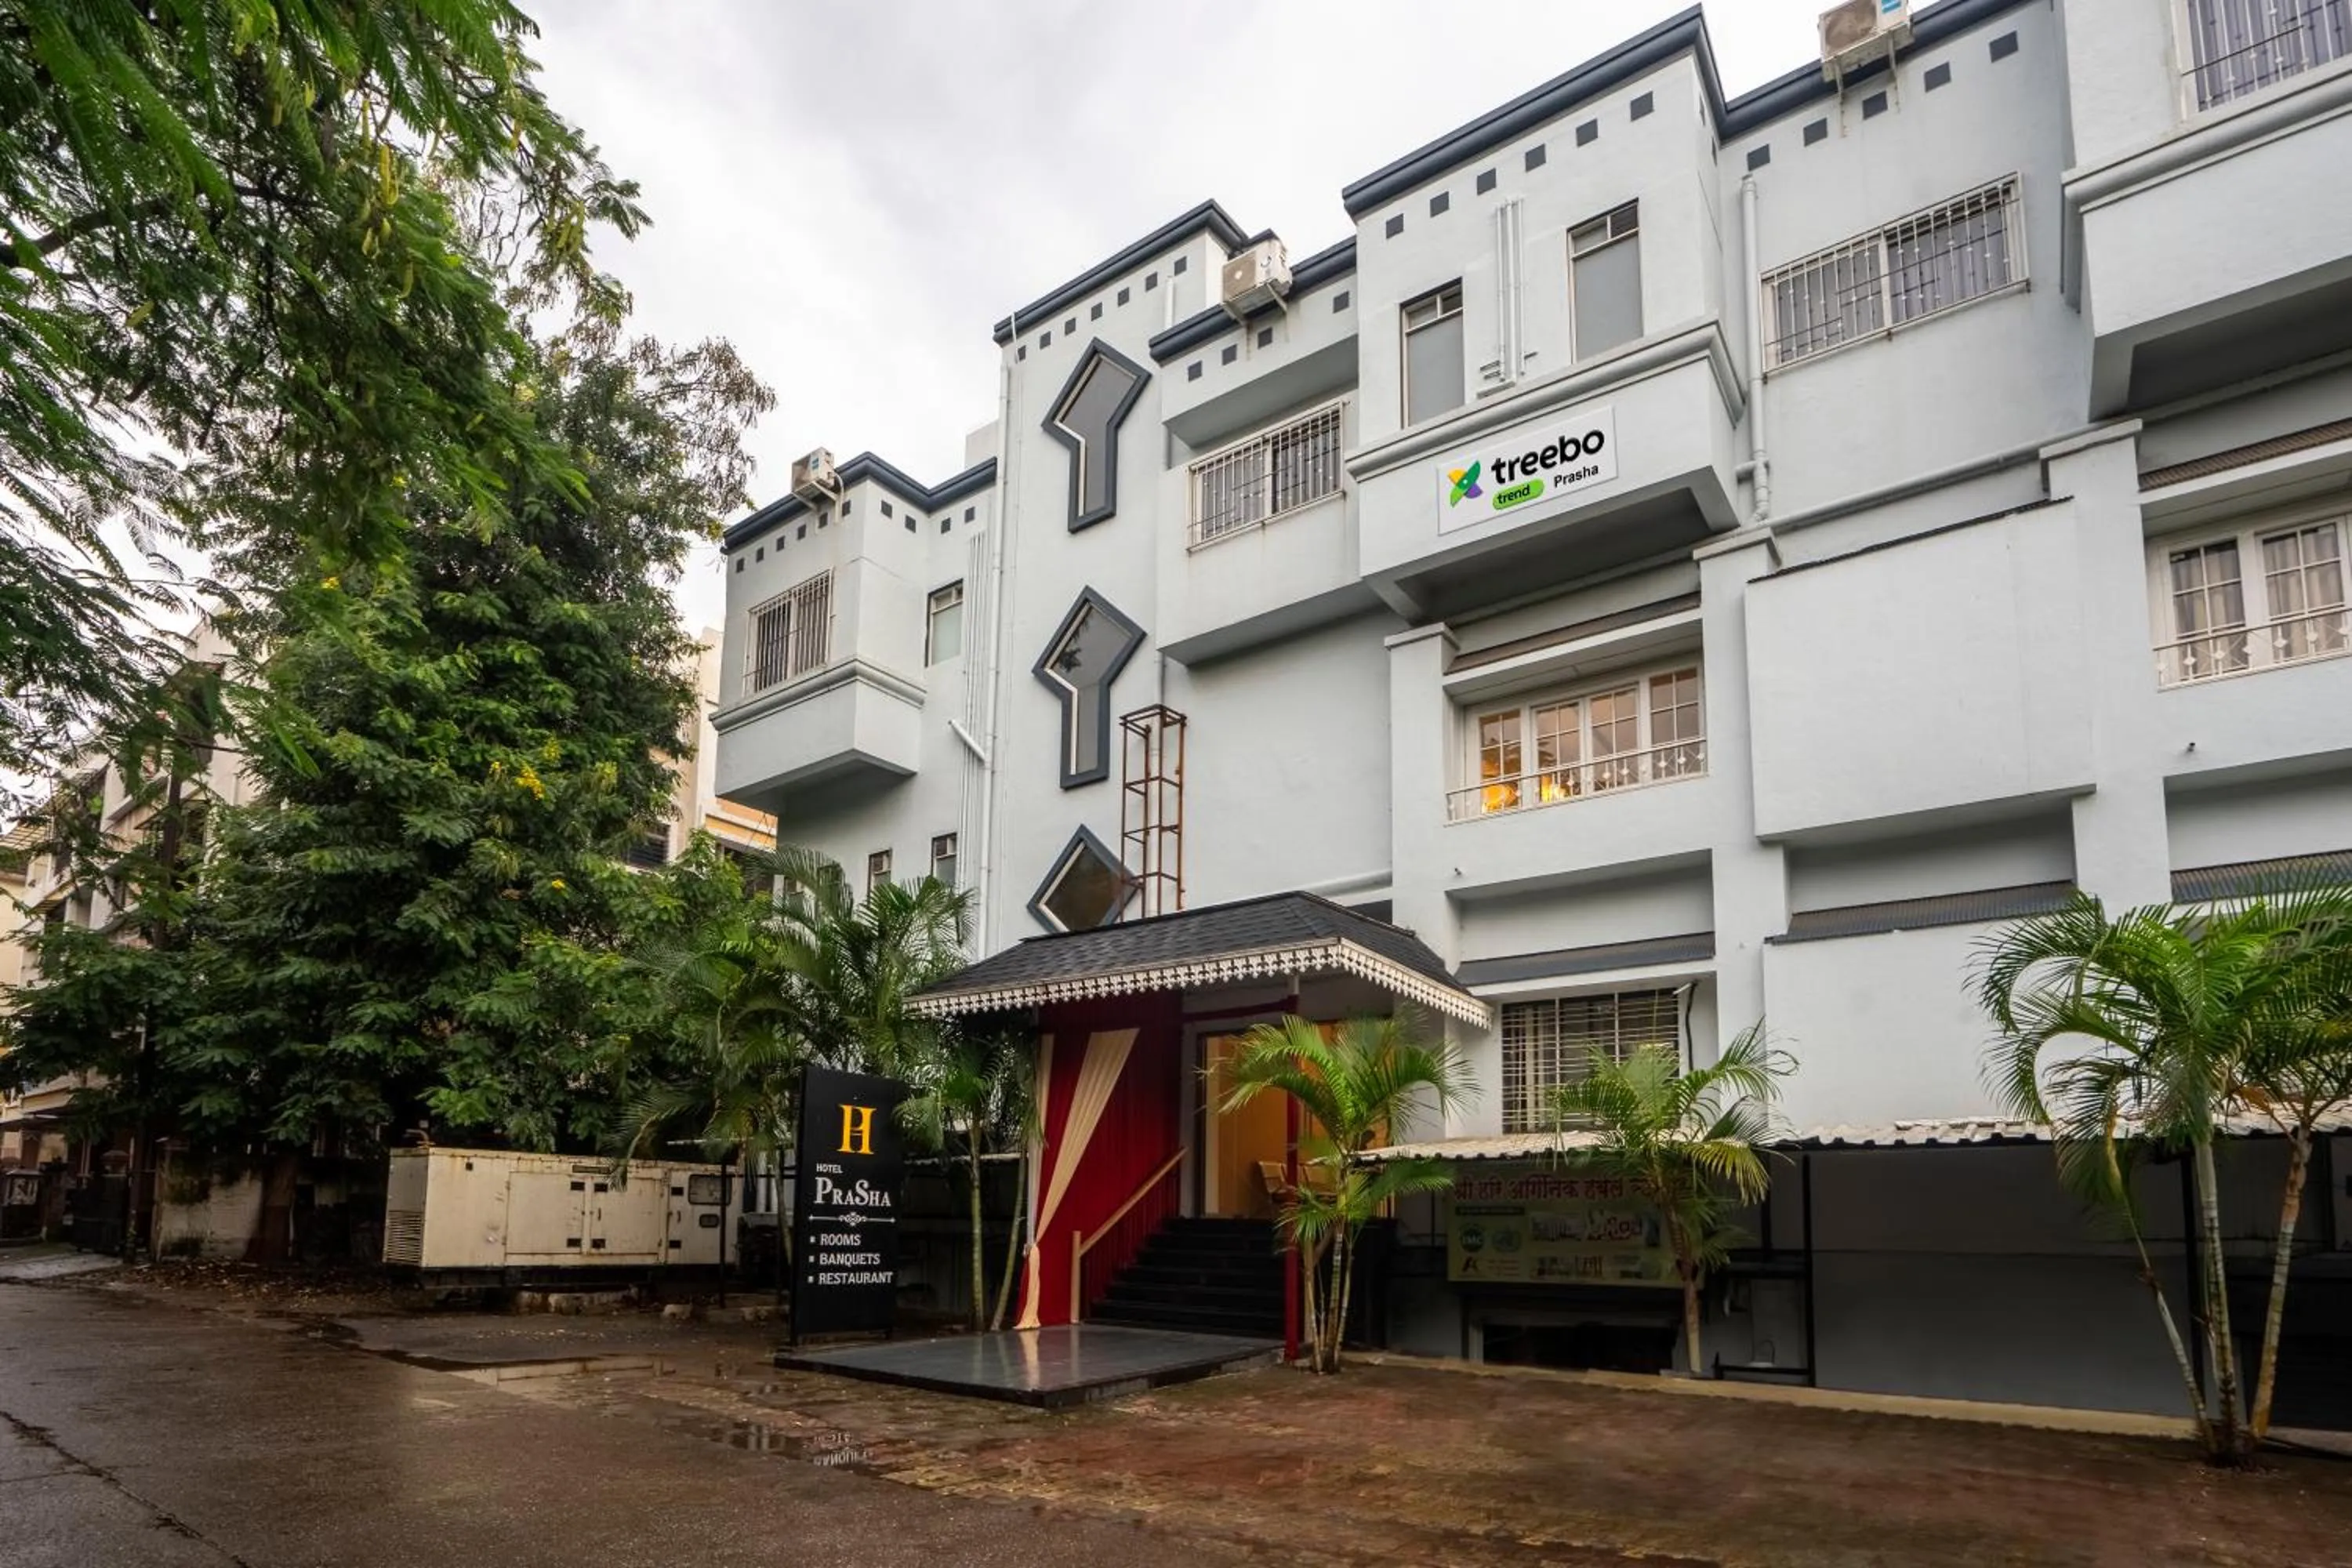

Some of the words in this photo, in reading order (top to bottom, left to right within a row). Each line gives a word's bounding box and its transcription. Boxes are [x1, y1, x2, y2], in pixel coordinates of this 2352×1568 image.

[1490, 430, 1605, 484] treebo
[1553, 465, 1599, 488] Prasha
[1497, 485, 1530, 504] trend
[816, 1163, 843, 1174] HOTEL
[820, 1234, 862, 1247] ROOMS
[819, 1254, 880, 1267] BANQUETS
[818, 1272, 894, 1285] RESTAURANT
